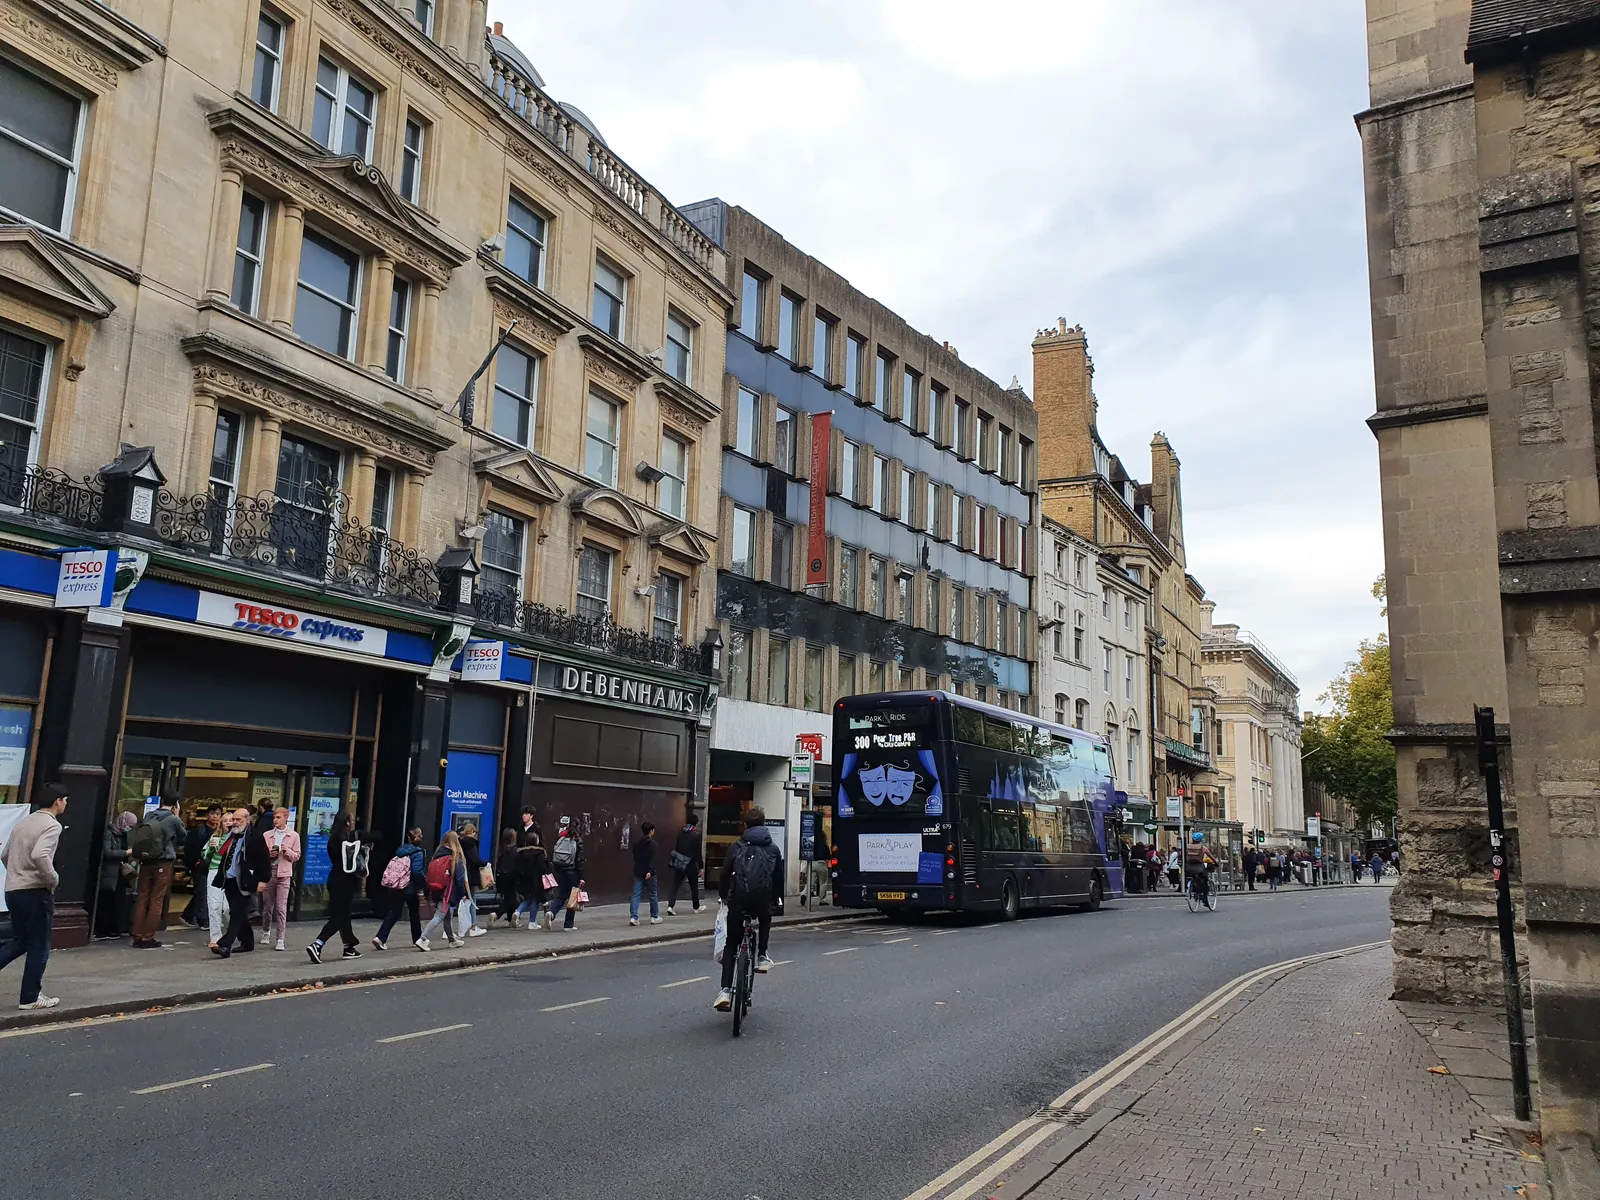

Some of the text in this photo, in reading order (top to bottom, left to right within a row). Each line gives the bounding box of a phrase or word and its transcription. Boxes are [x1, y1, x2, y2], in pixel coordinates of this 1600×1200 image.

[810, 505, 818, 537] BRITISH
[65, 561, 103, 575] TESCO
[62, 580, 98, 595] express
[234, 602, 365, 643] TESCO express
[467, 648, 500, 660] TESCO
[466, 661, 497, 672] express
[562, 667, 695, 713] DEBENHAMS
[890, 713, 907, 721] RIDE
[855, 732, 916, 749] 300 Pear Tree P&R
[446, 789, 488, 800] Cash Machine
[311, 799, 333, 809] Hello.
[866, 841, 886, 849] PARK
[894, 840, 914, 849] PLAY
